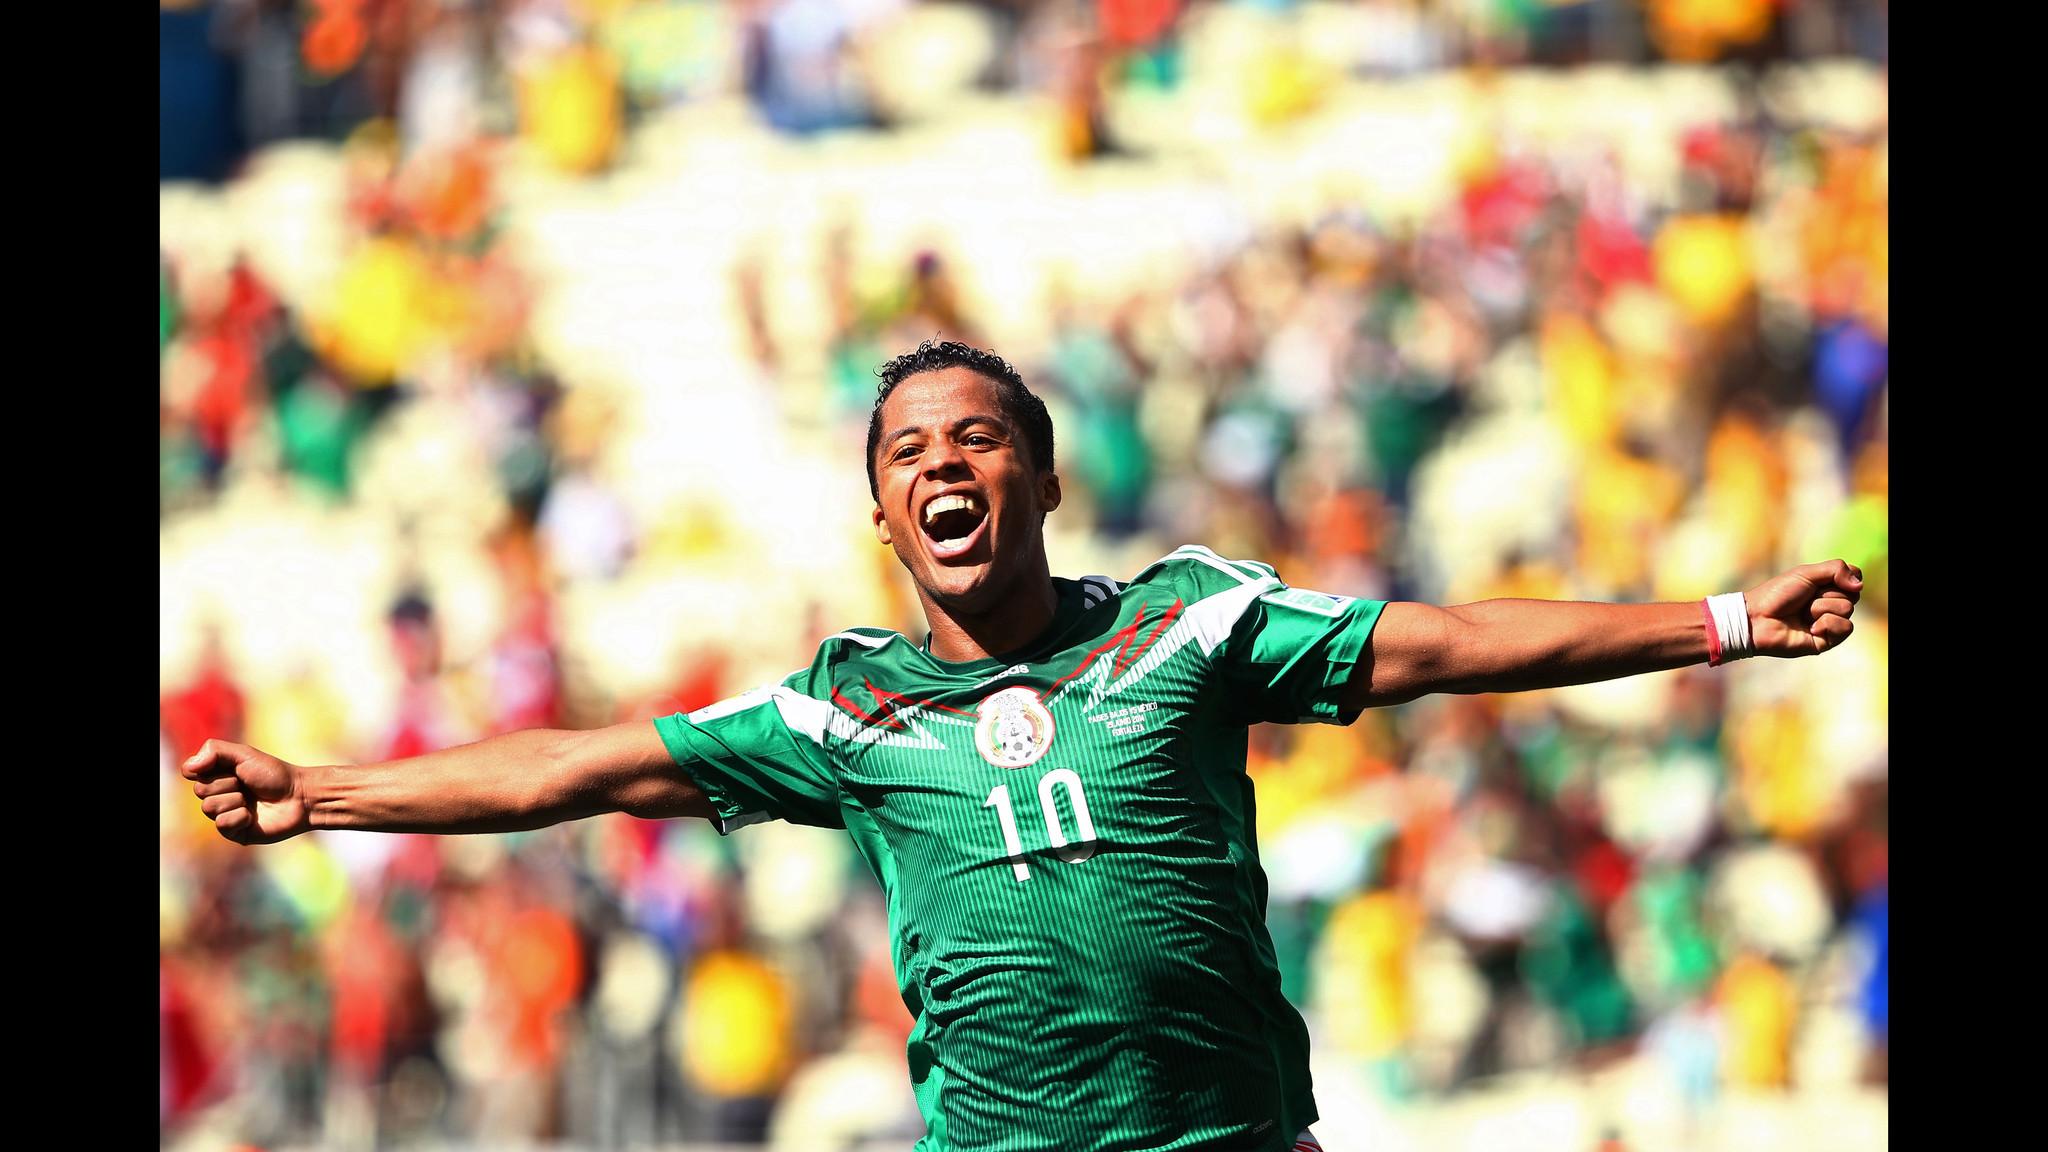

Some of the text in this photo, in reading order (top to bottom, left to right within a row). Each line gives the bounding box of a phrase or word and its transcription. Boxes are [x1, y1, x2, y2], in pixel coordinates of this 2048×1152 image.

[973, 664, 1030, 689] das
[1112, 724, 1145, 736] FORTALEZA
[1115, 717, 1131, 726] JUNIO
[983, 768, 1097, 882] 10
